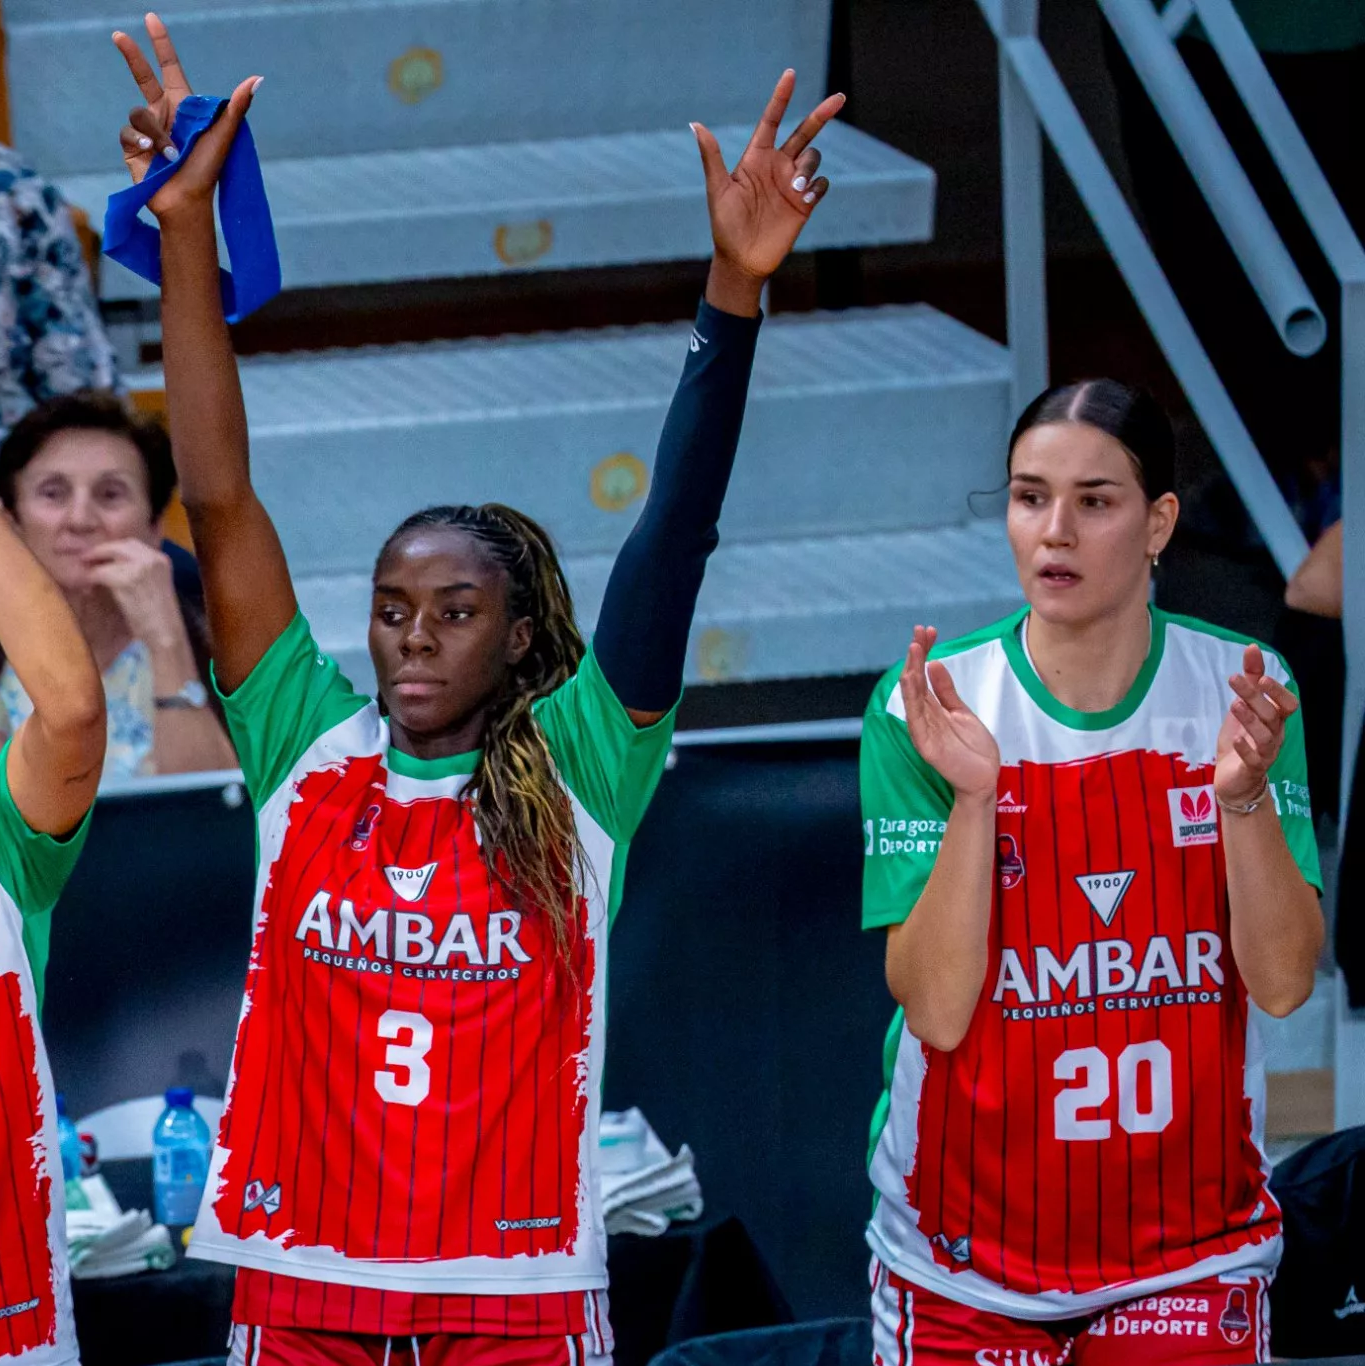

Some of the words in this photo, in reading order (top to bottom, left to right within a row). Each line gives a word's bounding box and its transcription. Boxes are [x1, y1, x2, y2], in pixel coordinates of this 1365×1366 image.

[391, 869, 424, 881] 1900
[1087, 877, 1120, 890] 1900
[295, 890, 532, 966] AMBAR
[304, 948, 393, 975] PEQUEÑOS
[402, 967, 520, 980] CERVECEROS
[992, 930, 1225, 1004] AMBAR
[1003, 1001, 1096, 1020] PEQUEÑOS
[1104, 991, 1222, 1009] CERVECEROS
[374, 1008, 434, 1106] 3
[1053, 1038, 1173, 1141] 20
[1114, 1315, 1208, 1337] DEPORTE
